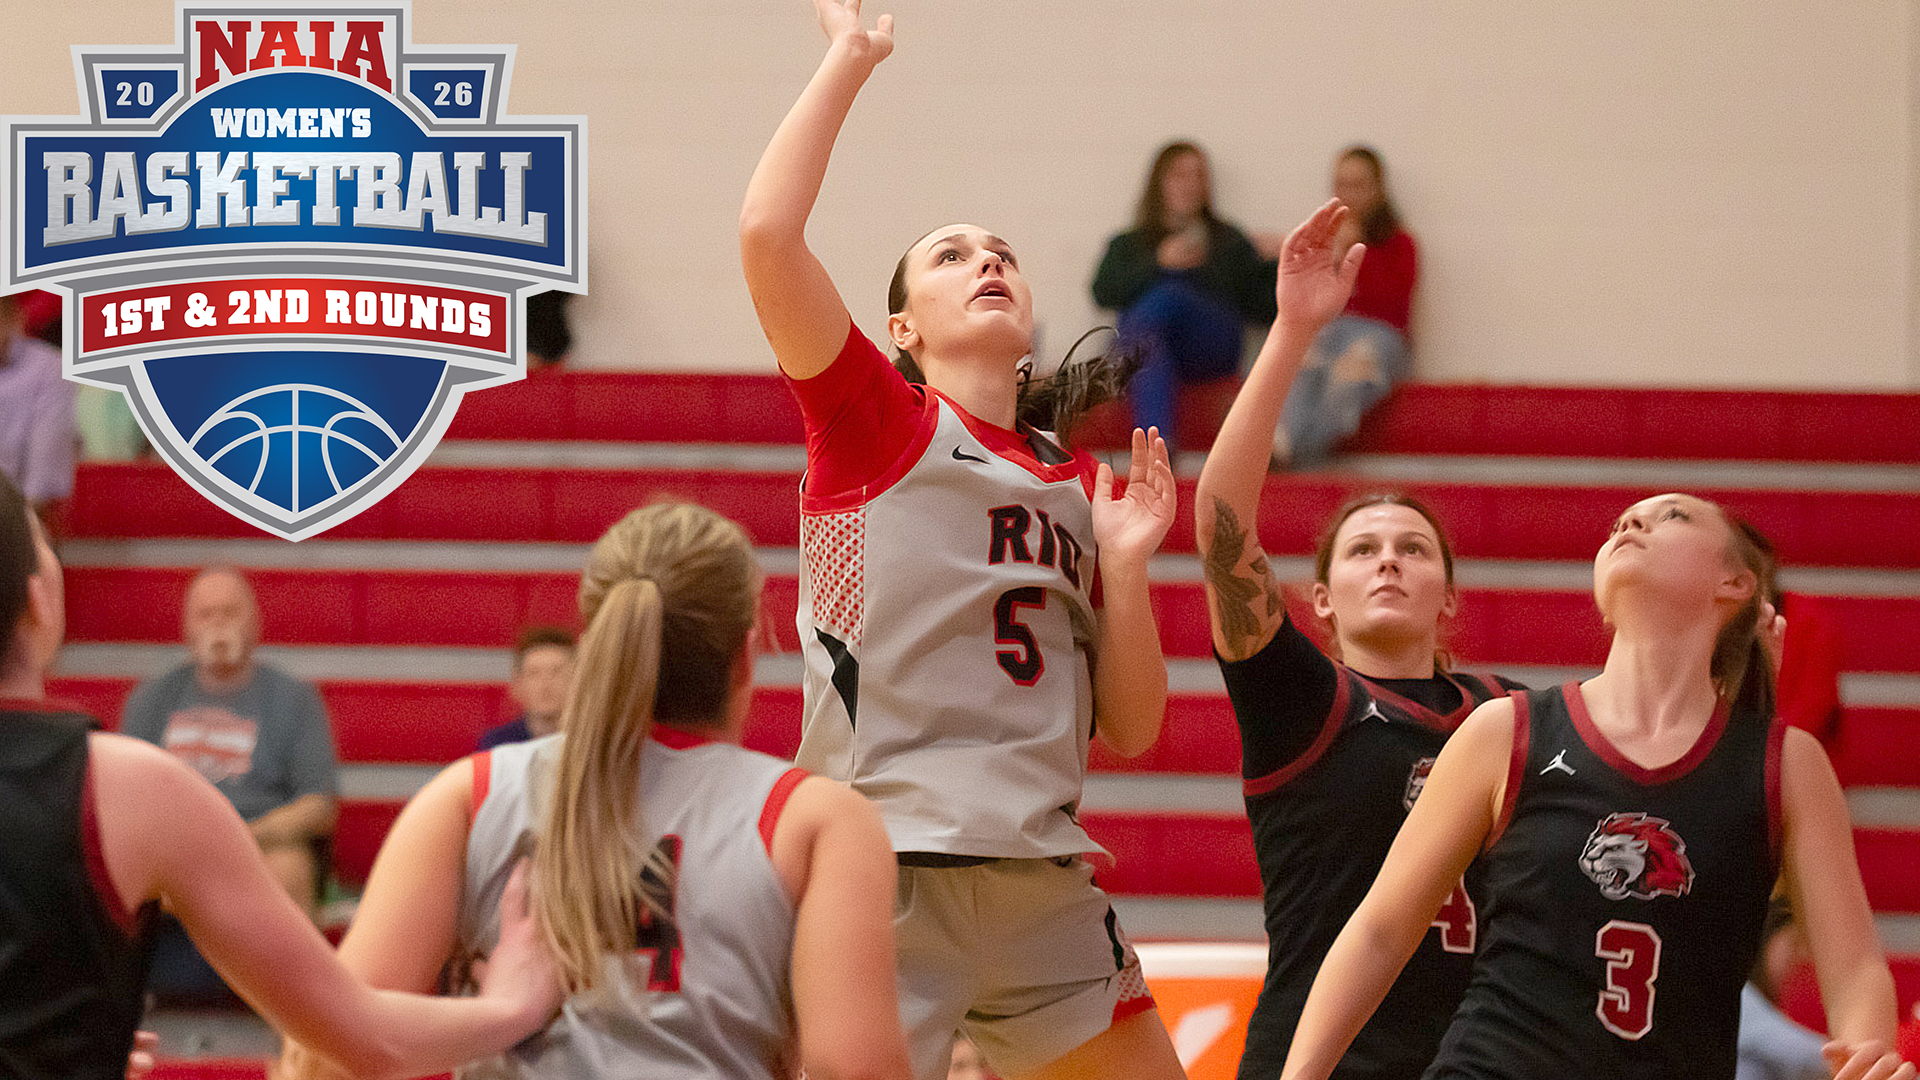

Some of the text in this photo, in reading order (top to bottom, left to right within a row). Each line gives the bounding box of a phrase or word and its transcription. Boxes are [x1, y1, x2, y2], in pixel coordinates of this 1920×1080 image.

[987, 503, 1083, 591] RIO
[993, 586, 1046, 688] 5
[1594, 918, 1662, 1041] 3
